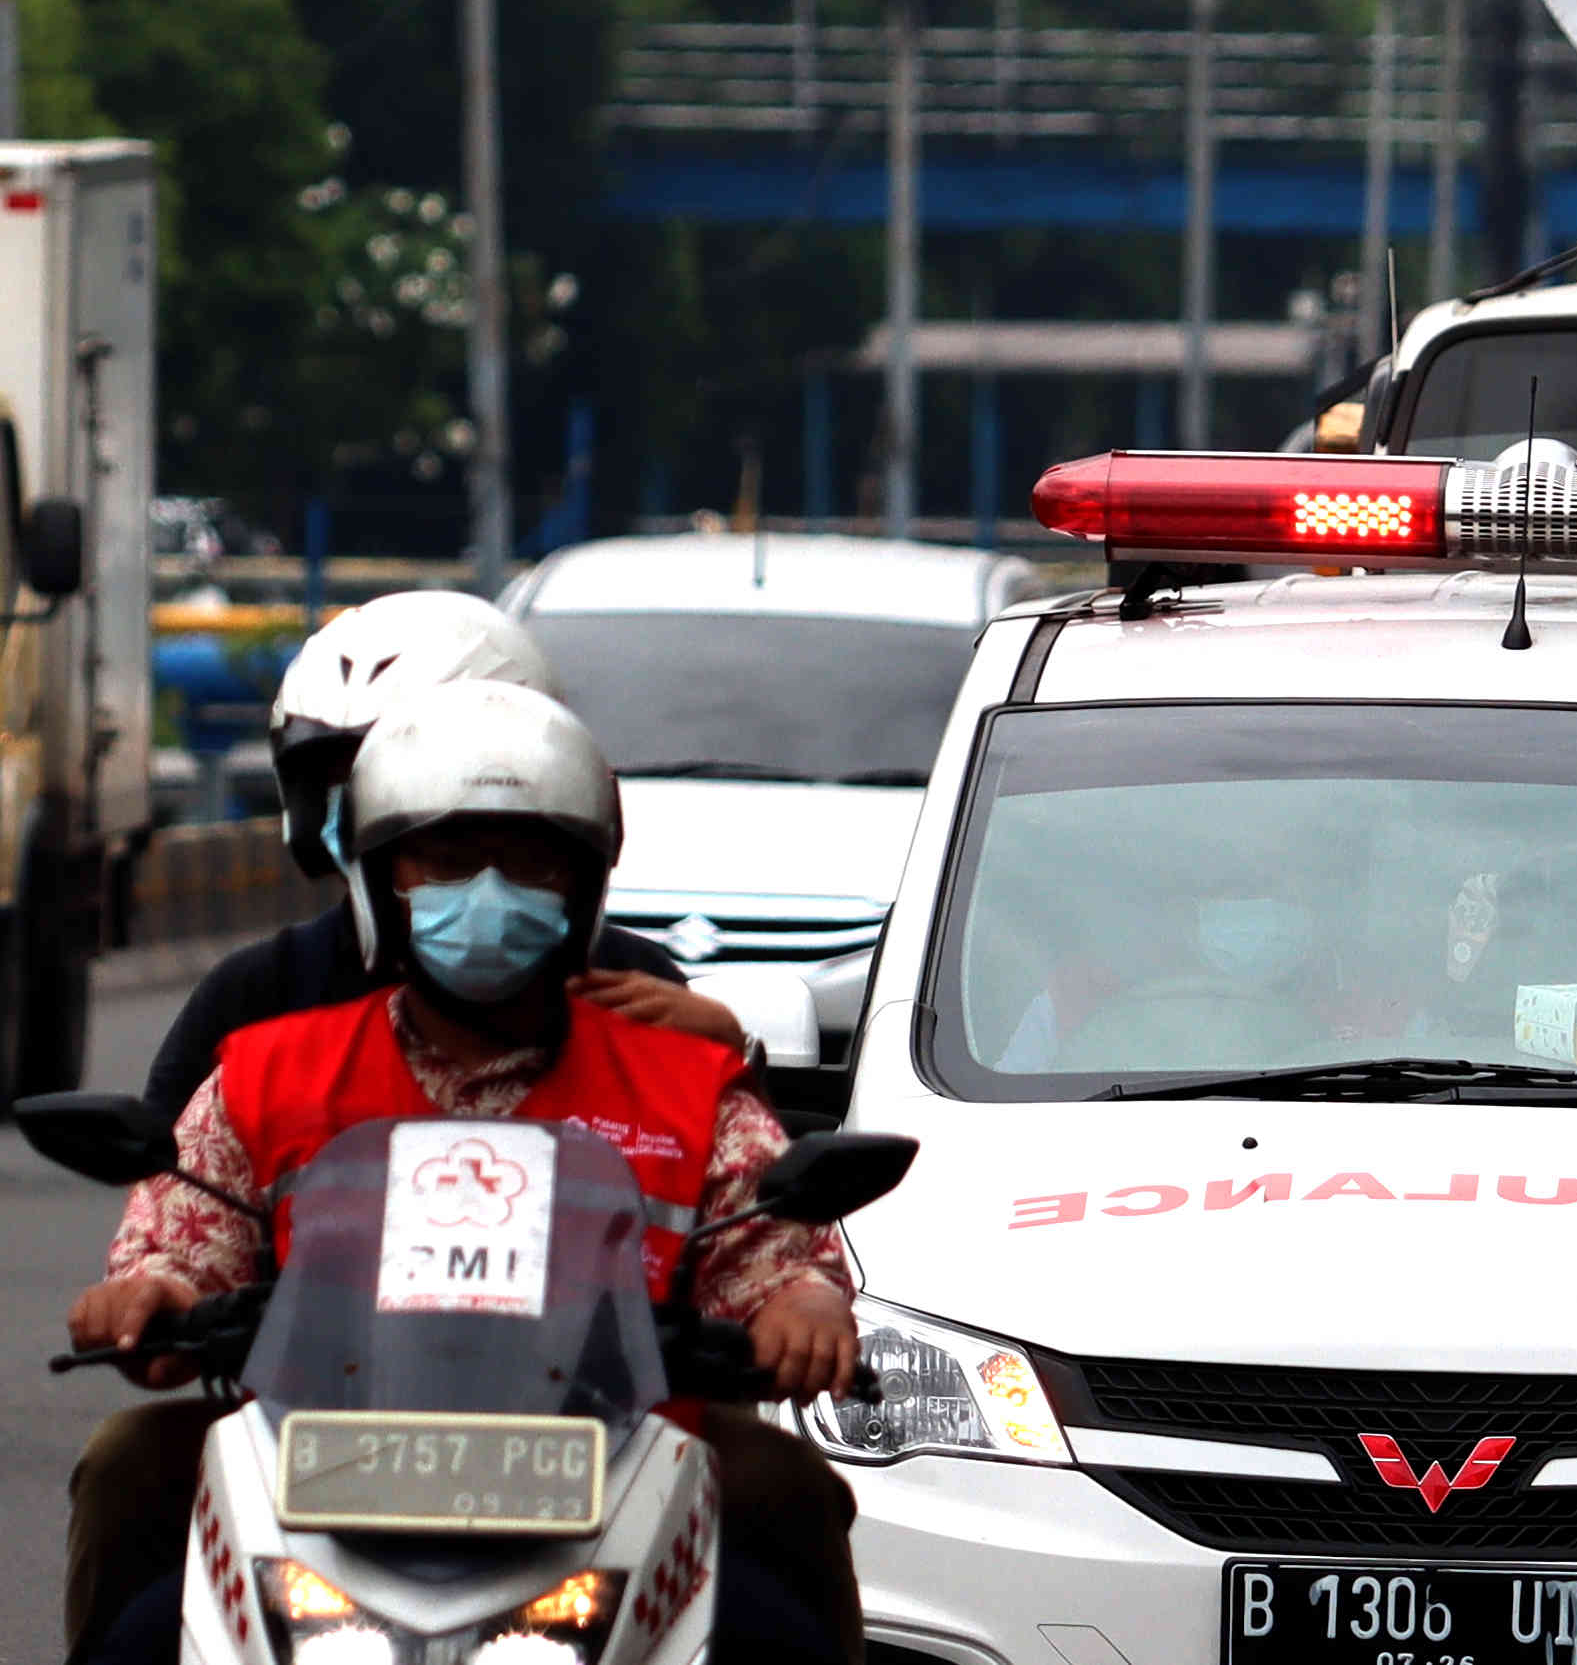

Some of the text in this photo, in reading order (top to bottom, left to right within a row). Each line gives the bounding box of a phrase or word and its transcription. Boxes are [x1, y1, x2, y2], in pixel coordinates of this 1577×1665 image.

[295, 1431, 318, 1471] B
[356, 1432, 469, 1475] 3757
[1243, 1572, 1275, 1637] B
